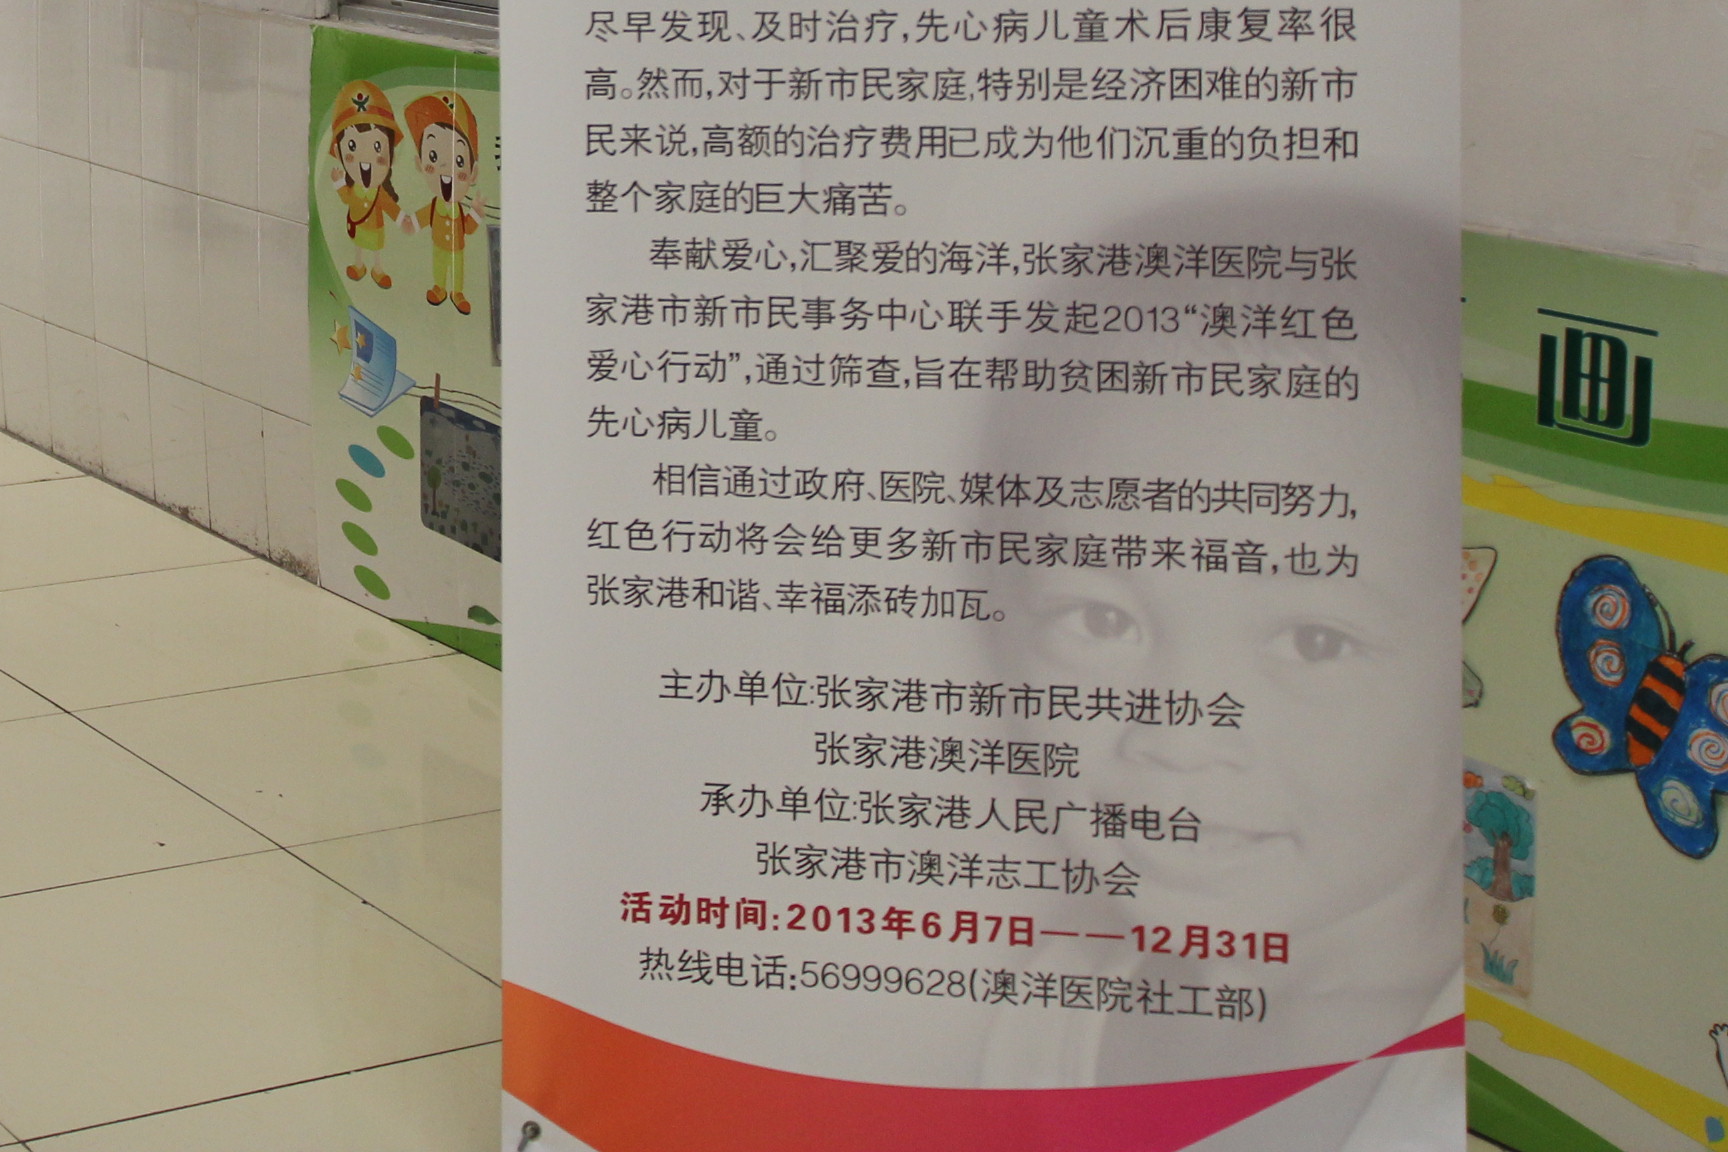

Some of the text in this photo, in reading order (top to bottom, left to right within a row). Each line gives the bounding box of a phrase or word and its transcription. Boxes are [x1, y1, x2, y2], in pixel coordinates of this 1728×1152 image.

[585, 7, 1356, 45] 尽早发现、及时治疗，先心病儿童术后康复率很
[586, 123, 1358, 162] 民来说，高额的治疗费用已成为他们沉重的负担和
[586, 178, 907, 216] 整个家庭的巨大痛苦。
[650, 236, 1357, 281] 奉献爱心，汇聚爱的海洋，张家港澳洋医院与张
[586, 405, 777, 442] 先心病儿童。
[586, 518, 1358, 578] 红色行动将会给更多新市民家庭带来福音，也为
[586, 574, 1006, 622] 张家港和谐、幸福添砖加瓦。
[658, 668, 1245, 729] 主办单位：张家港市新市民共进协会
[814, 730, 1080, 778] 张家港澳洋医院
[699, 781, 1201, 843] 承办单位：张家港人民广播电台
[755, 842, 1140, 898] 张家港市澳洋志工协会
